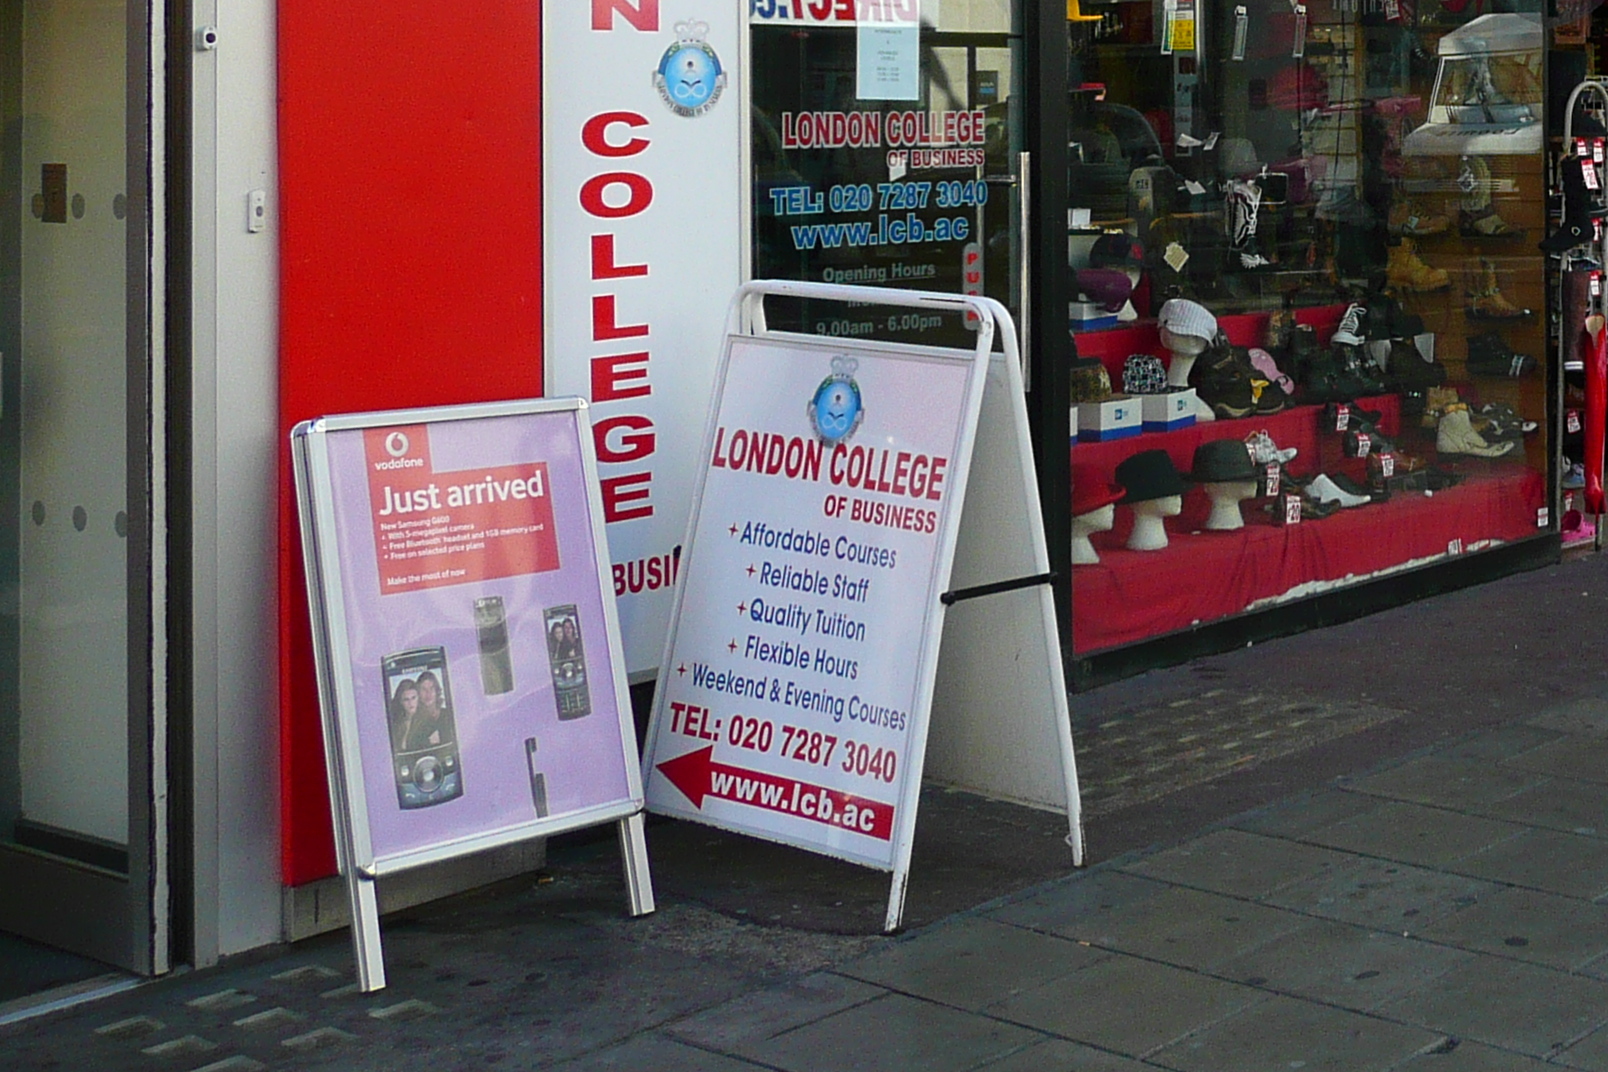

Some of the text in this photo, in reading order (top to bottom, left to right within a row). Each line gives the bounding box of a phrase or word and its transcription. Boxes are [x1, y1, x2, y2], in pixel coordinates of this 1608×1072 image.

[782, 110, 985, 149] LONDON COLLEGE
[887, 148, 984, 168] OF BUSINESS
[770, 180, 988, 215] TEL: 020 7287 3040
[791, 213, 969, 249] www.lcb.ac
[823, 263, 936, 283] Opening Hours
[579, 110, 656, 525] COLLEGE
[375, 456, 424, 471] vodafone
[712, 427, 946, 500] LONDON COLLEGE
[380, 469, 544, 516] Just arrived
[824, 495, 937, 534] OF BUSINESS
[740, 521, 896, 569] Affordable Courses
[760, 561, 869, 603] Reliable Staff
[749, 599, 865, 641] Quality Tuition
[745, 635, 858, 680] Flexible Hours
[692, 661, 906, 731] Weekend & Evening Courses
[671, 702, 896, 782] TEL: 020 7287 3040
[711, 768, 875, 832] www.lcb.ac
